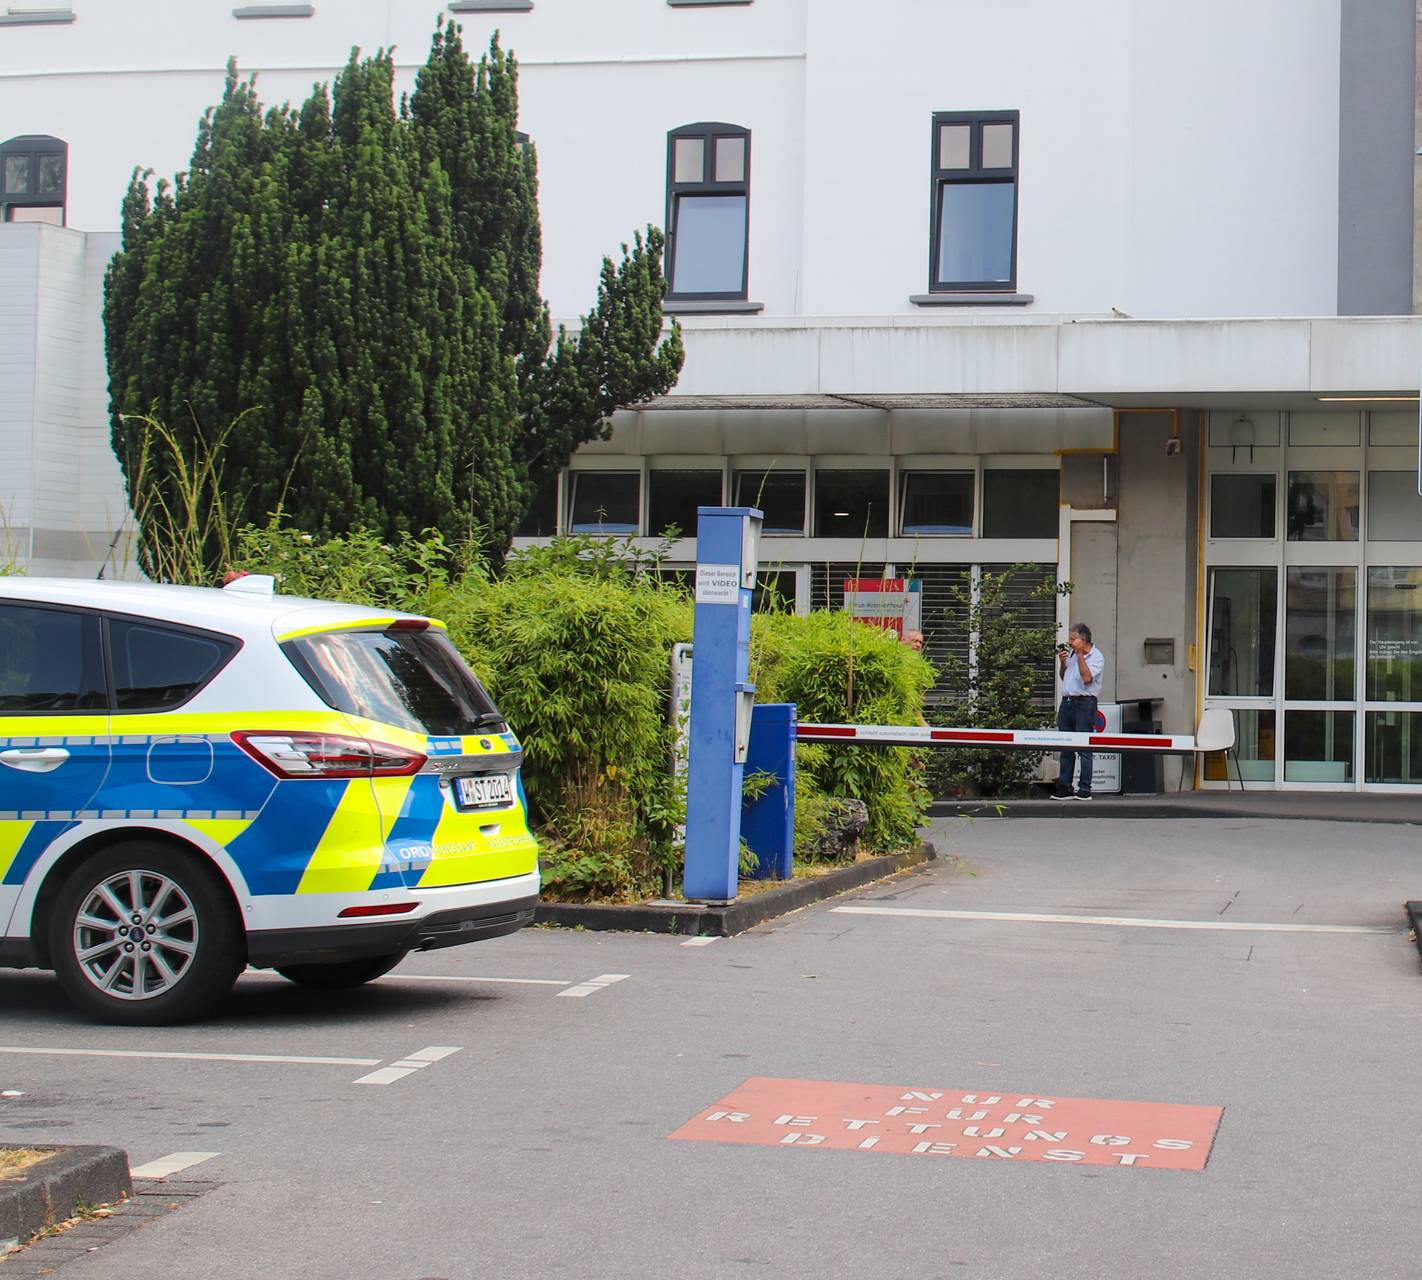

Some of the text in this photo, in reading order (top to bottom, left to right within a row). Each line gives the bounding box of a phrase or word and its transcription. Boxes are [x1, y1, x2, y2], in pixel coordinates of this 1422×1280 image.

[474, 780, 486, 801] ST
[487, 778, 509, 799] 2014
[900, 1091, 1056, 1109] NUR
[705, 1111, 1194, 1150] RETTUNGS
[780, 1132, 1149, 1166] DIENST
